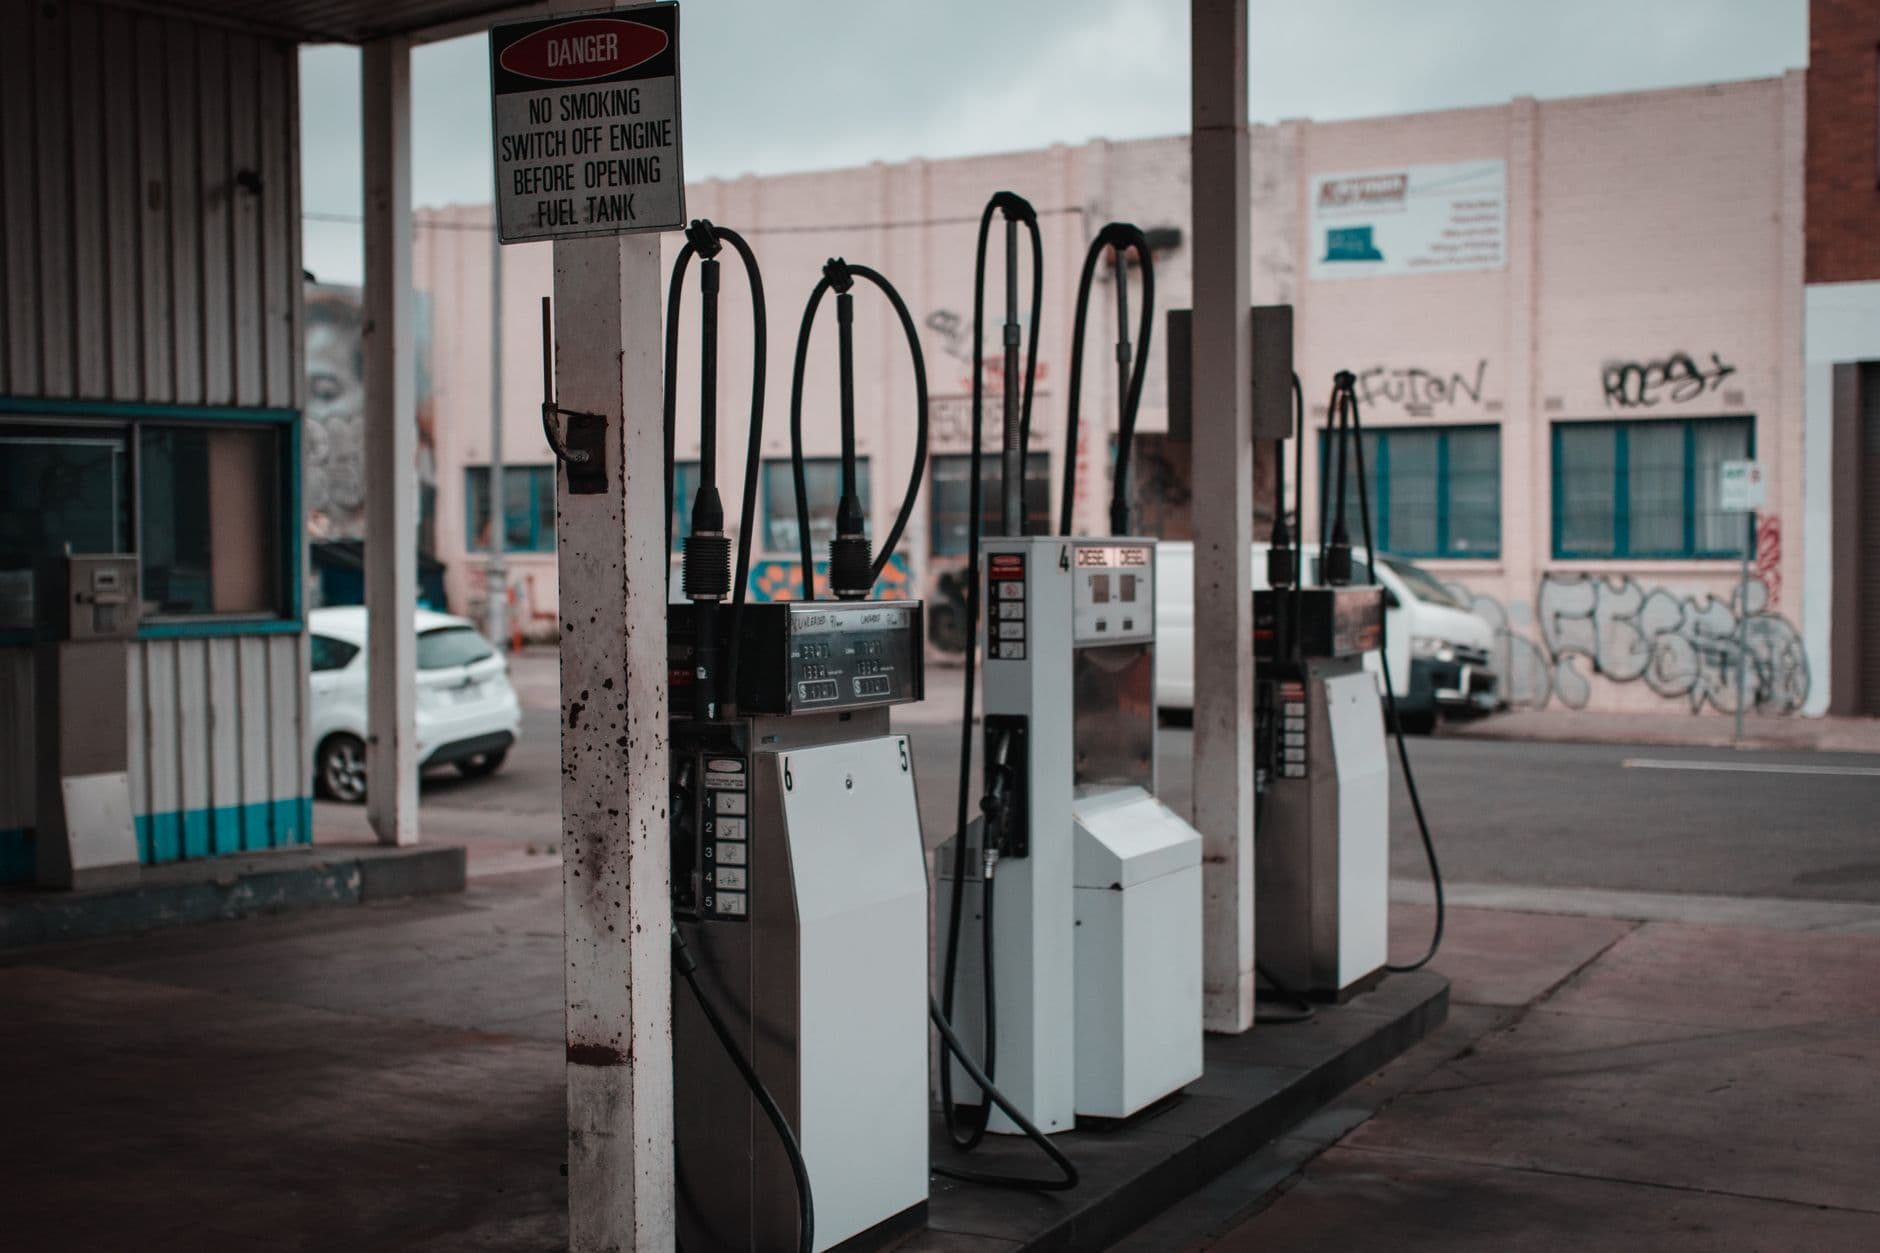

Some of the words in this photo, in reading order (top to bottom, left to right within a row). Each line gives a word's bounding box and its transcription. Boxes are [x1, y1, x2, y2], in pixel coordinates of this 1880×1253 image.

[547, 33, 619, 68] DANGER
[529, 97, 552, 125] NO
[560, 88, 640, 122] SMOKING
[502, 130, 566, 162] SWITCH
[572, 126, 602, 155] OFF
[610, 119, 672, 152] ENGINE
[513, 163, 575, 196] BEFORE
[584, 156, 661, 189] OPENING
[538, 198, 578, 228] FUEL
[586, 193, 636, 224] TANK
[1059, 544, 1069, 572] 4
[783, 756, 793, 791] 6
[898, 740, 908, 772] 5
[705, 822, 713, 833] 2
[705, 847, 713, 858] 3
[705, 872, 713, 883] 4
